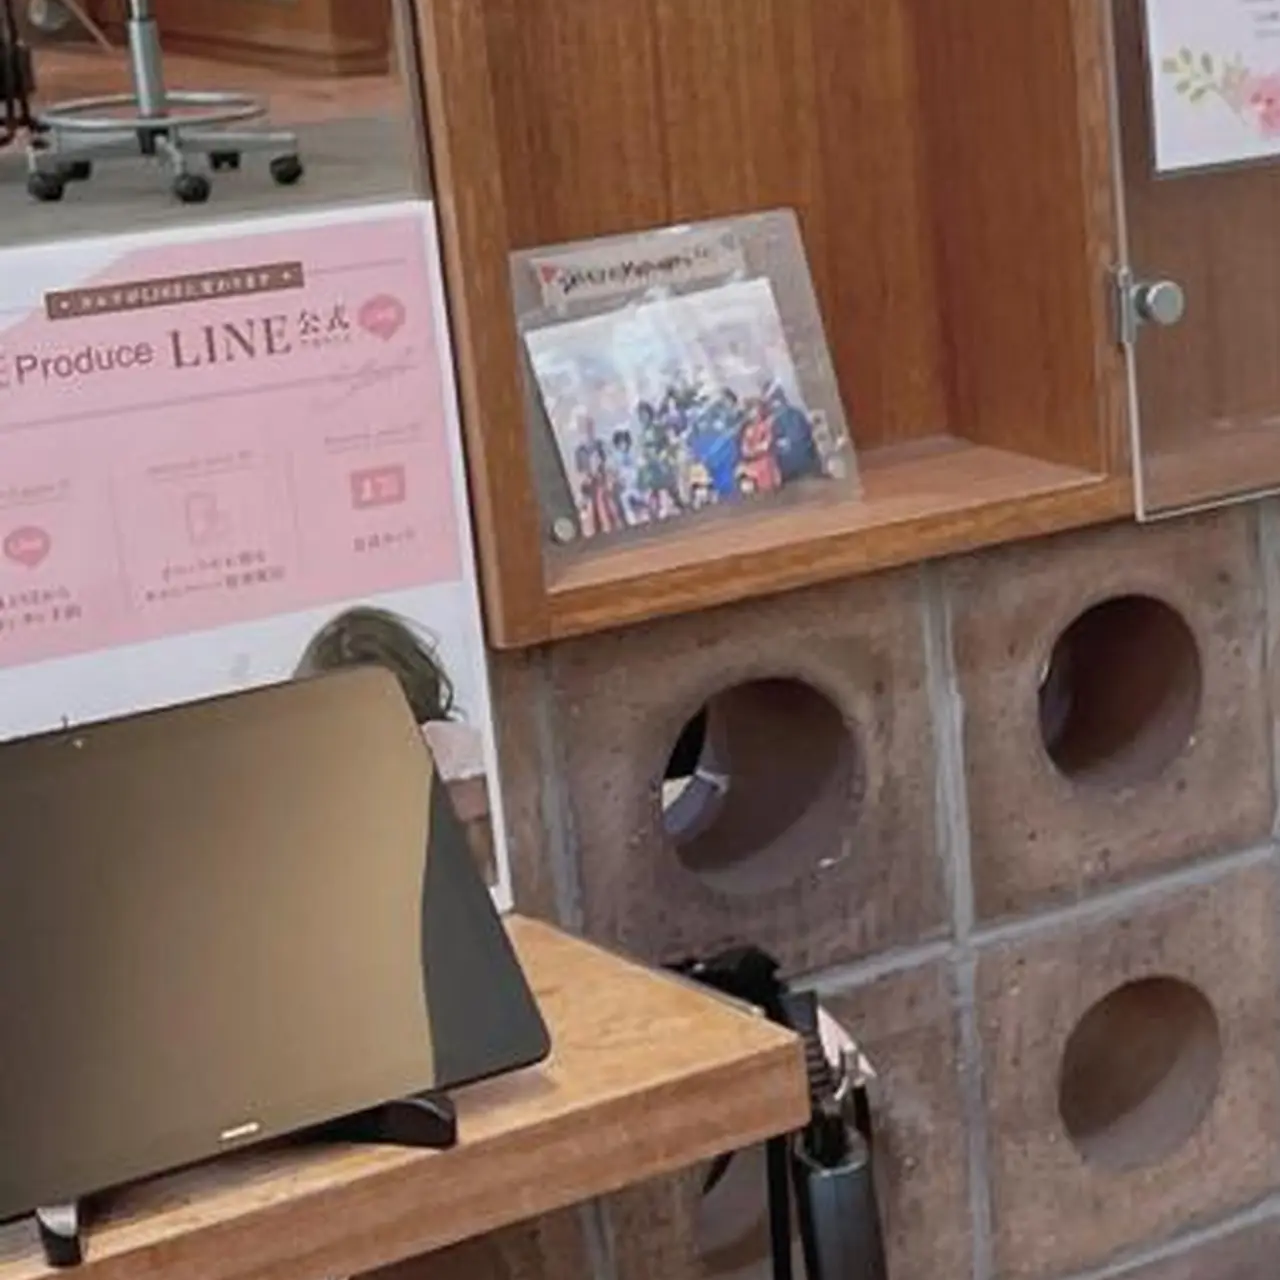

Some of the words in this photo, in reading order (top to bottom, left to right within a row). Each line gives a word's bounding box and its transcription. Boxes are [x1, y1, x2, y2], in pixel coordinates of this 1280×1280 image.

[15, 342, 154, 385] Produce
[169, 313, 293, 369] LINE
[300, 303, 350, 335] 公式
